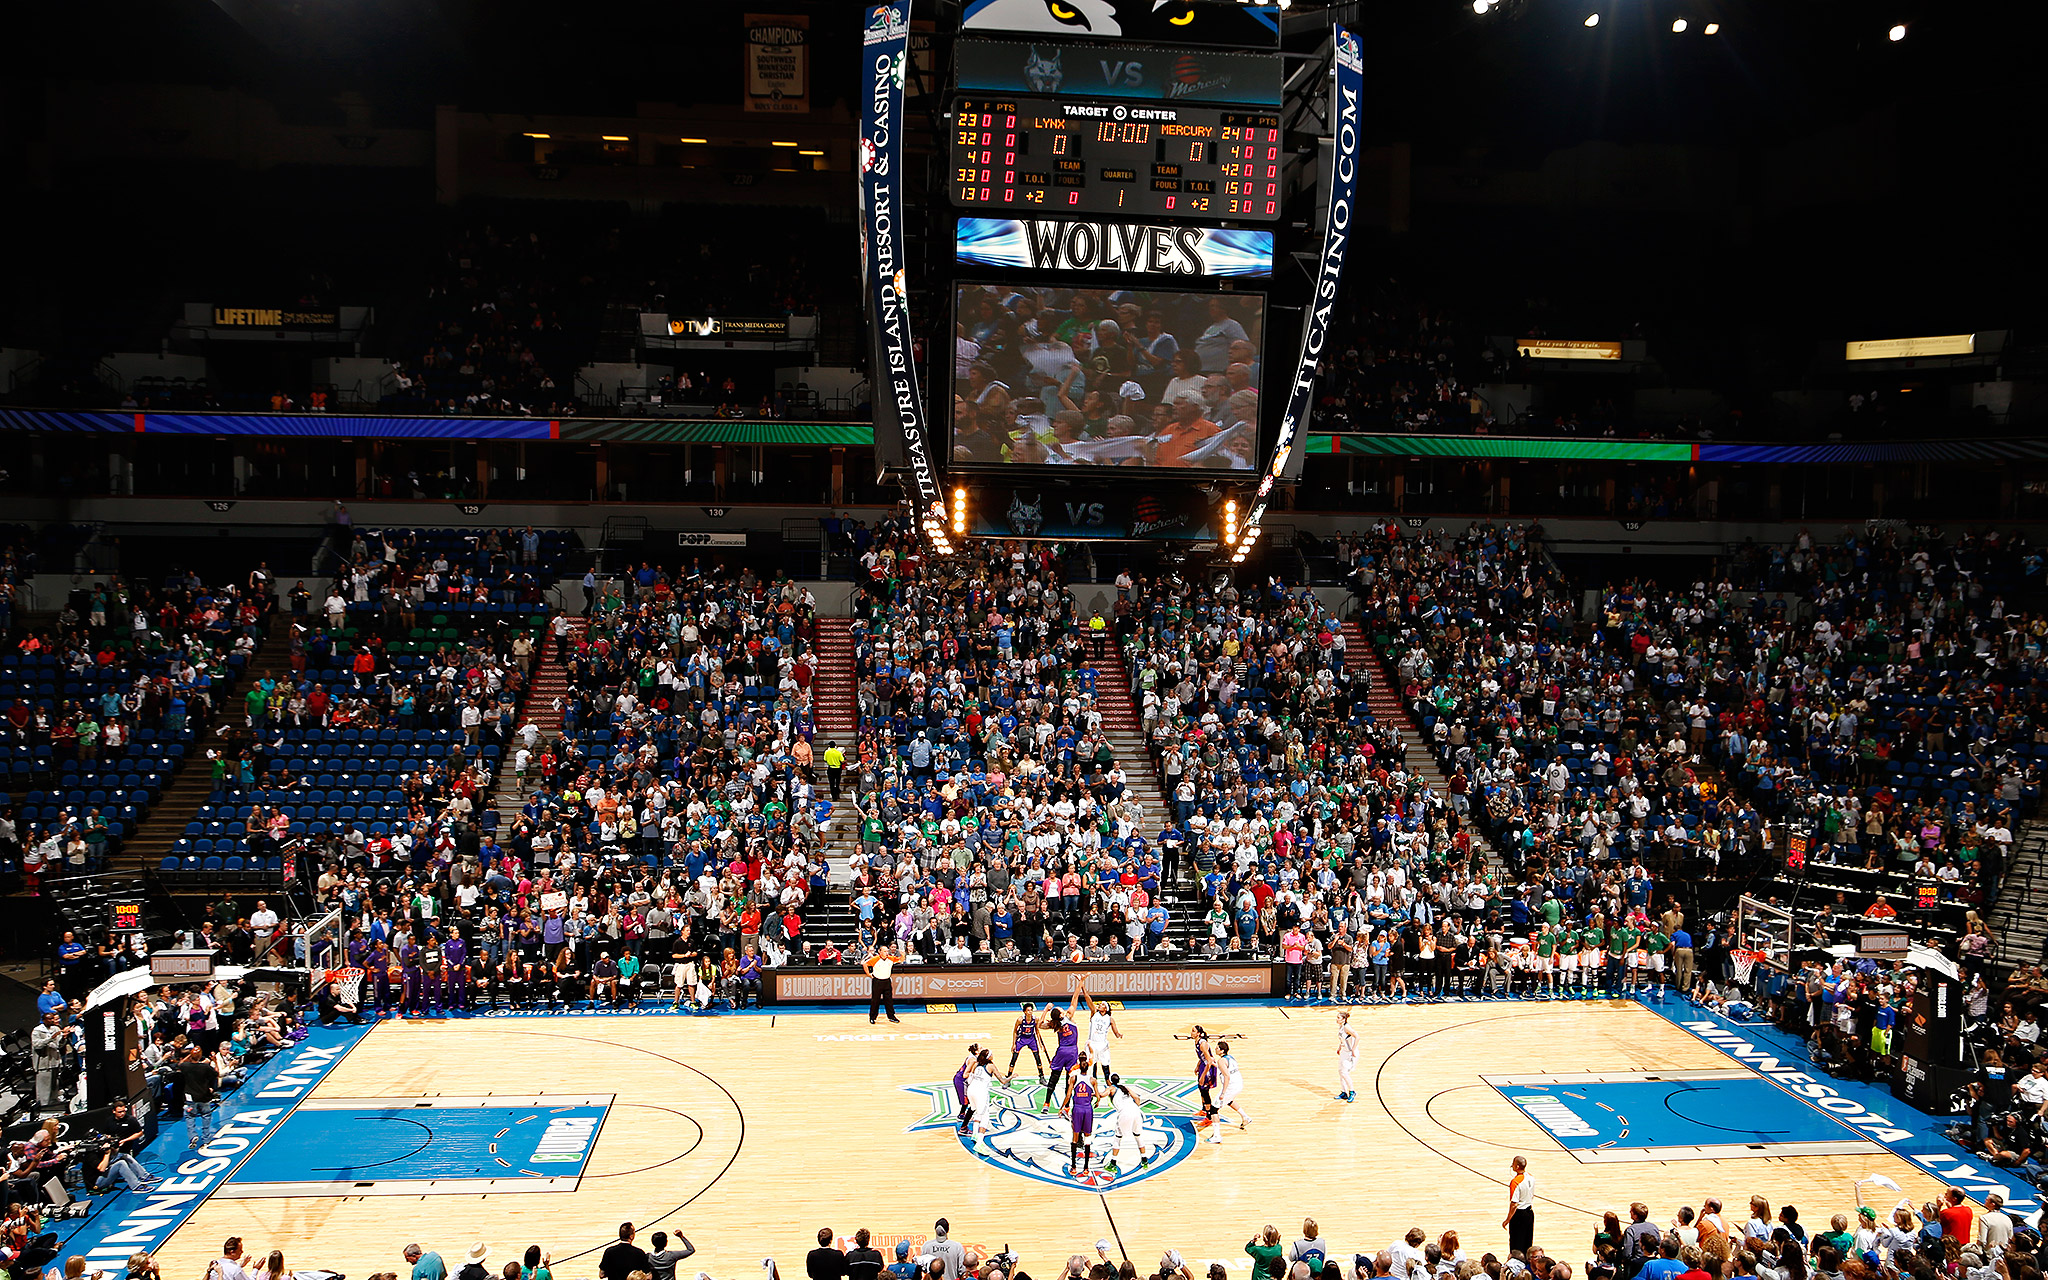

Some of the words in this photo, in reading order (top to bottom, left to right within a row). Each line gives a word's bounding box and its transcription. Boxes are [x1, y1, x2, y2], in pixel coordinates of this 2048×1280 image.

[750, 27, 804, 44] CHAMPIONS
[1099, 60, 1143, 86] VS
[874, 54, 891, 148] CASINO
[1063, 106, 1108, 117] TARGET
[1131, 110, 1176, 120] CENTER
[958, 113, 977, 126] 23
[982, 114, 992, 127] 0
[1006, 116, 1016, 128] 0
[1035, 118, 1065, 129] LYNX
[1259, 118, 1276, 126] PTS
[1097, 122, 1149, 143] 10:00
[1161, 124, 1213, 137] MERCURY
[1222, 127, 1240, 140] 24
[1245, 128, 1254, 141] 0
[1268, 129, 1277, 142] 0
[958, 132, 977, 145] 32
[982, 133, 991, 146] 0
[1005, 134, 1015, 147] 0
[1053, 135, 1067, 154] 0
[968, 151, 976, 163] 4
[981, 151, 991, 164] 0
[1005, 152, 1015, 165] 0
[1190, 142, 1203, 162] 0
[1231, 146, 1239, 158] 4
[1244, 146, 1254, 159] 0
[1267, 147, 1277, 160] 0
[874, 152, 889, 176] &
[1157, 166, 1177, 174] TEAM
[1221, 164, 1239, 176] 42
[1244, 164, 1253, 177] 0
[1267, 165, 1277, 178] 0
[957, 169, 976, 182] 33
[981, 169, 990, 182] 0
[1005, 171, 1014, 183] 0
[1104, 171, 1133, 179] QUARTER
[1156, 181, 1177, 189] FOULS
[1225, 182, 1238, 194] 15
[1244, 182, 1253, 195] 0
[1266, 183, 1276, 196] 0
[962, 187, 975, 200] 13
[981, 188, 990, 201] 0
[1004, 189, 1014, 202] 0
[1026, 190, 1044, 203] +2
[1068, 191, 1079, 205] 0
[1166, 196, 1176, 209] 0
[1191, 198, 1209, 211] +2
[1229, 200, 1238, 212] 3
[1243, 200, 1252, 213] 0
[1266, 201, 1275, 214] 0
[875, 182, 895, 278] RESORT
[1021, 220, 1205, 275] WOLVES
[1295, 85, 1358, 397] TICASINO.COM
[215, 307, 282, 326] LIFETIME
[881, 285, 906, 374] ISLAND
[1567, 341, 1580, 349] legs
[893, 378, 935, 499] TREASURE
[212, 502, 229, 511] 126
[463, 506, 479, 514] 129
[708, 508, 724, 517] 130
[1065, 502, 1105, 526] VS
[1409, 519, 1422, 527] 133
[1626, 522, 1639, 530] 136
[1788, 849, 1805, 869] 24
[1918, 888, 1937, 896] 10:00
[1919, 896, 1935, 908] 24
[115, 905, 140, 914] 10:00
[117, 915, 136, 927] 24
[947, 978, 984, 989] boost
[1116, 972, 1173, 993] PLAYOFFS
[1176, 971, 1203, 992] 2013
[1226, 973, 1261, 984] boost
[834, 977, 872, 997] PLAYO
[895, 975, 924, 996] 2013
[813, 1034, 900, 1042] TARGET
[903, 1032, 992, 1041] CENTER
[255, 1045, 346, 1099] LYNX
[1078, 1083, 1087, 1093] 24
[1679, 1019, 1914, 1144] MINNESOTA
